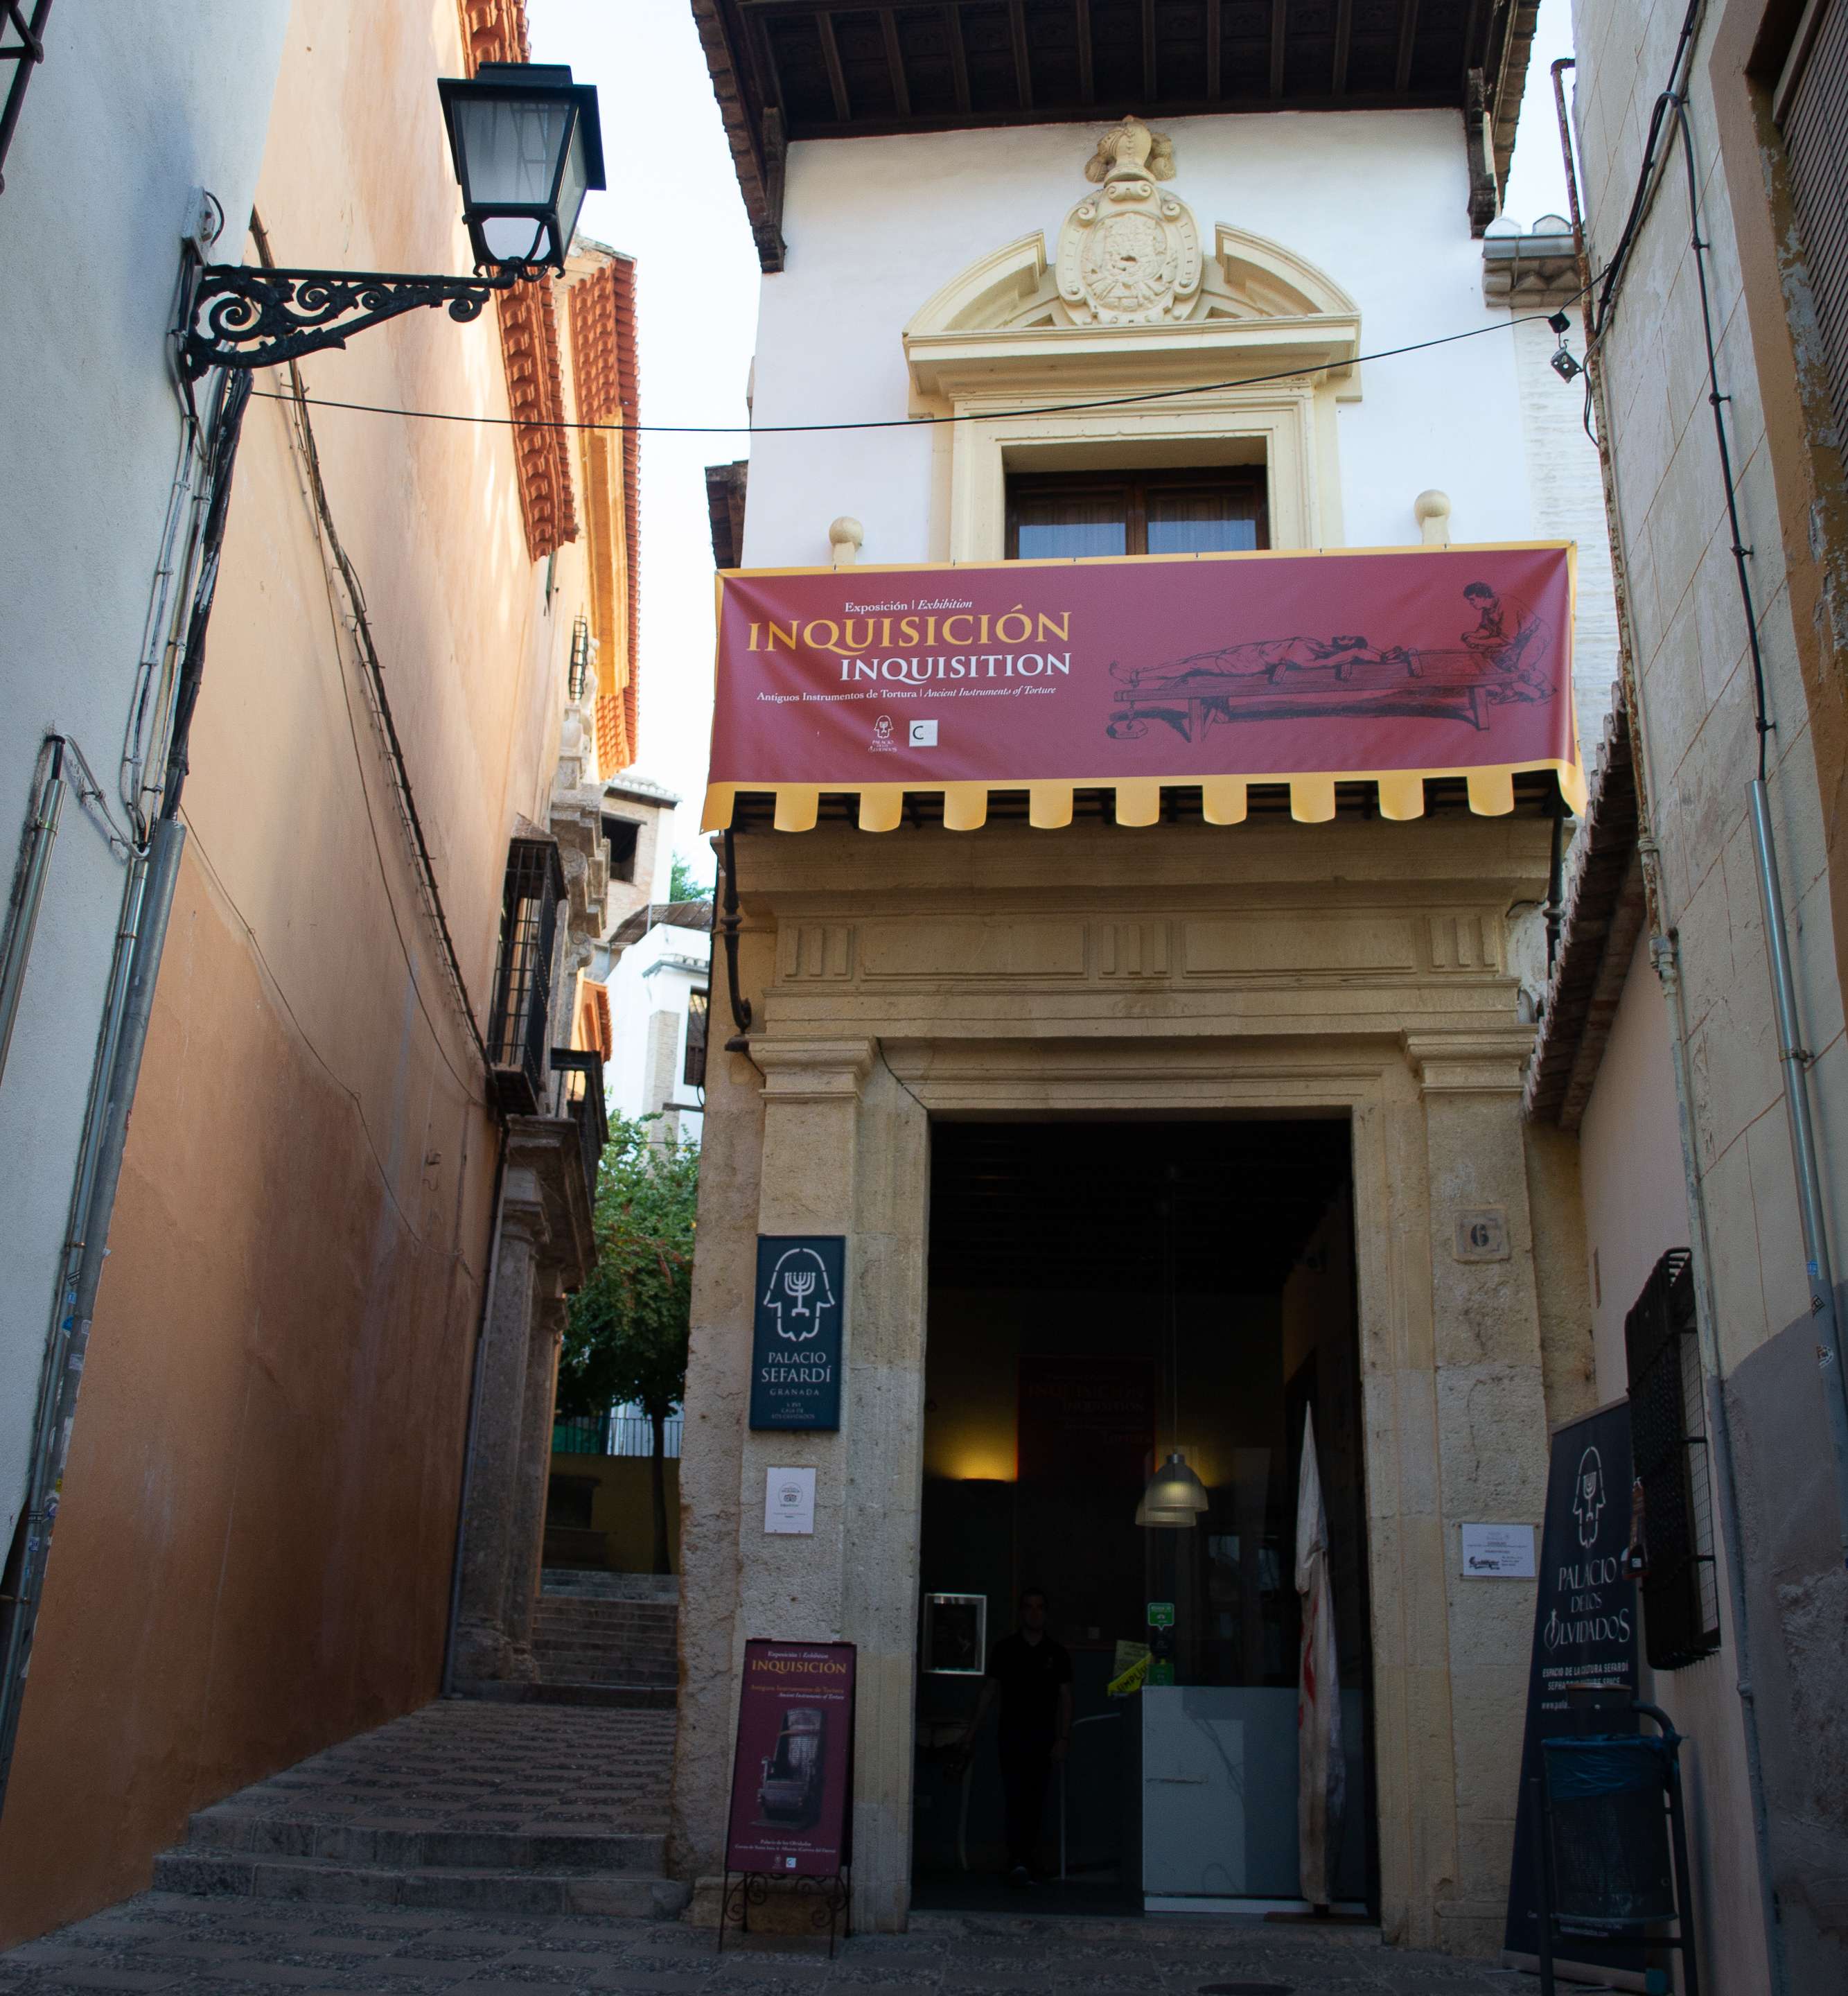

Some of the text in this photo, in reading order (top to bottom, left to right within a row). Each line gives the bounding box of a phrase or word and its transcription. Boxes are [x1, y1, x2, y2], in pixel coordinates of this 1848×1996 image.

[845, 598, 973, 614] Exposición Exhibition
[746, 604, 1072, 656] INQUISICIÓN
[839, 652, 1072, 685] INQUISITION
[757, 685, 1057, 704] Antiguos Instrumentos de Tortura Ancient Instruments of Torture
[1470, 1223, 1489, 1247] 6
[768, 1351, 827, 1364] PALACIO
[761, 1365, 832, 1383] SEFARDÍ
[769, 1388, 820, 1397] GRANADA
[1558, 1557, 1617, 1591] PALACIO
[1544, 1608, 1630, 1650] OLVIDADOS
[752, 1659, 847, 1674] INQUISICIÓN
[1565, 1667, 1573, 1676] DE
